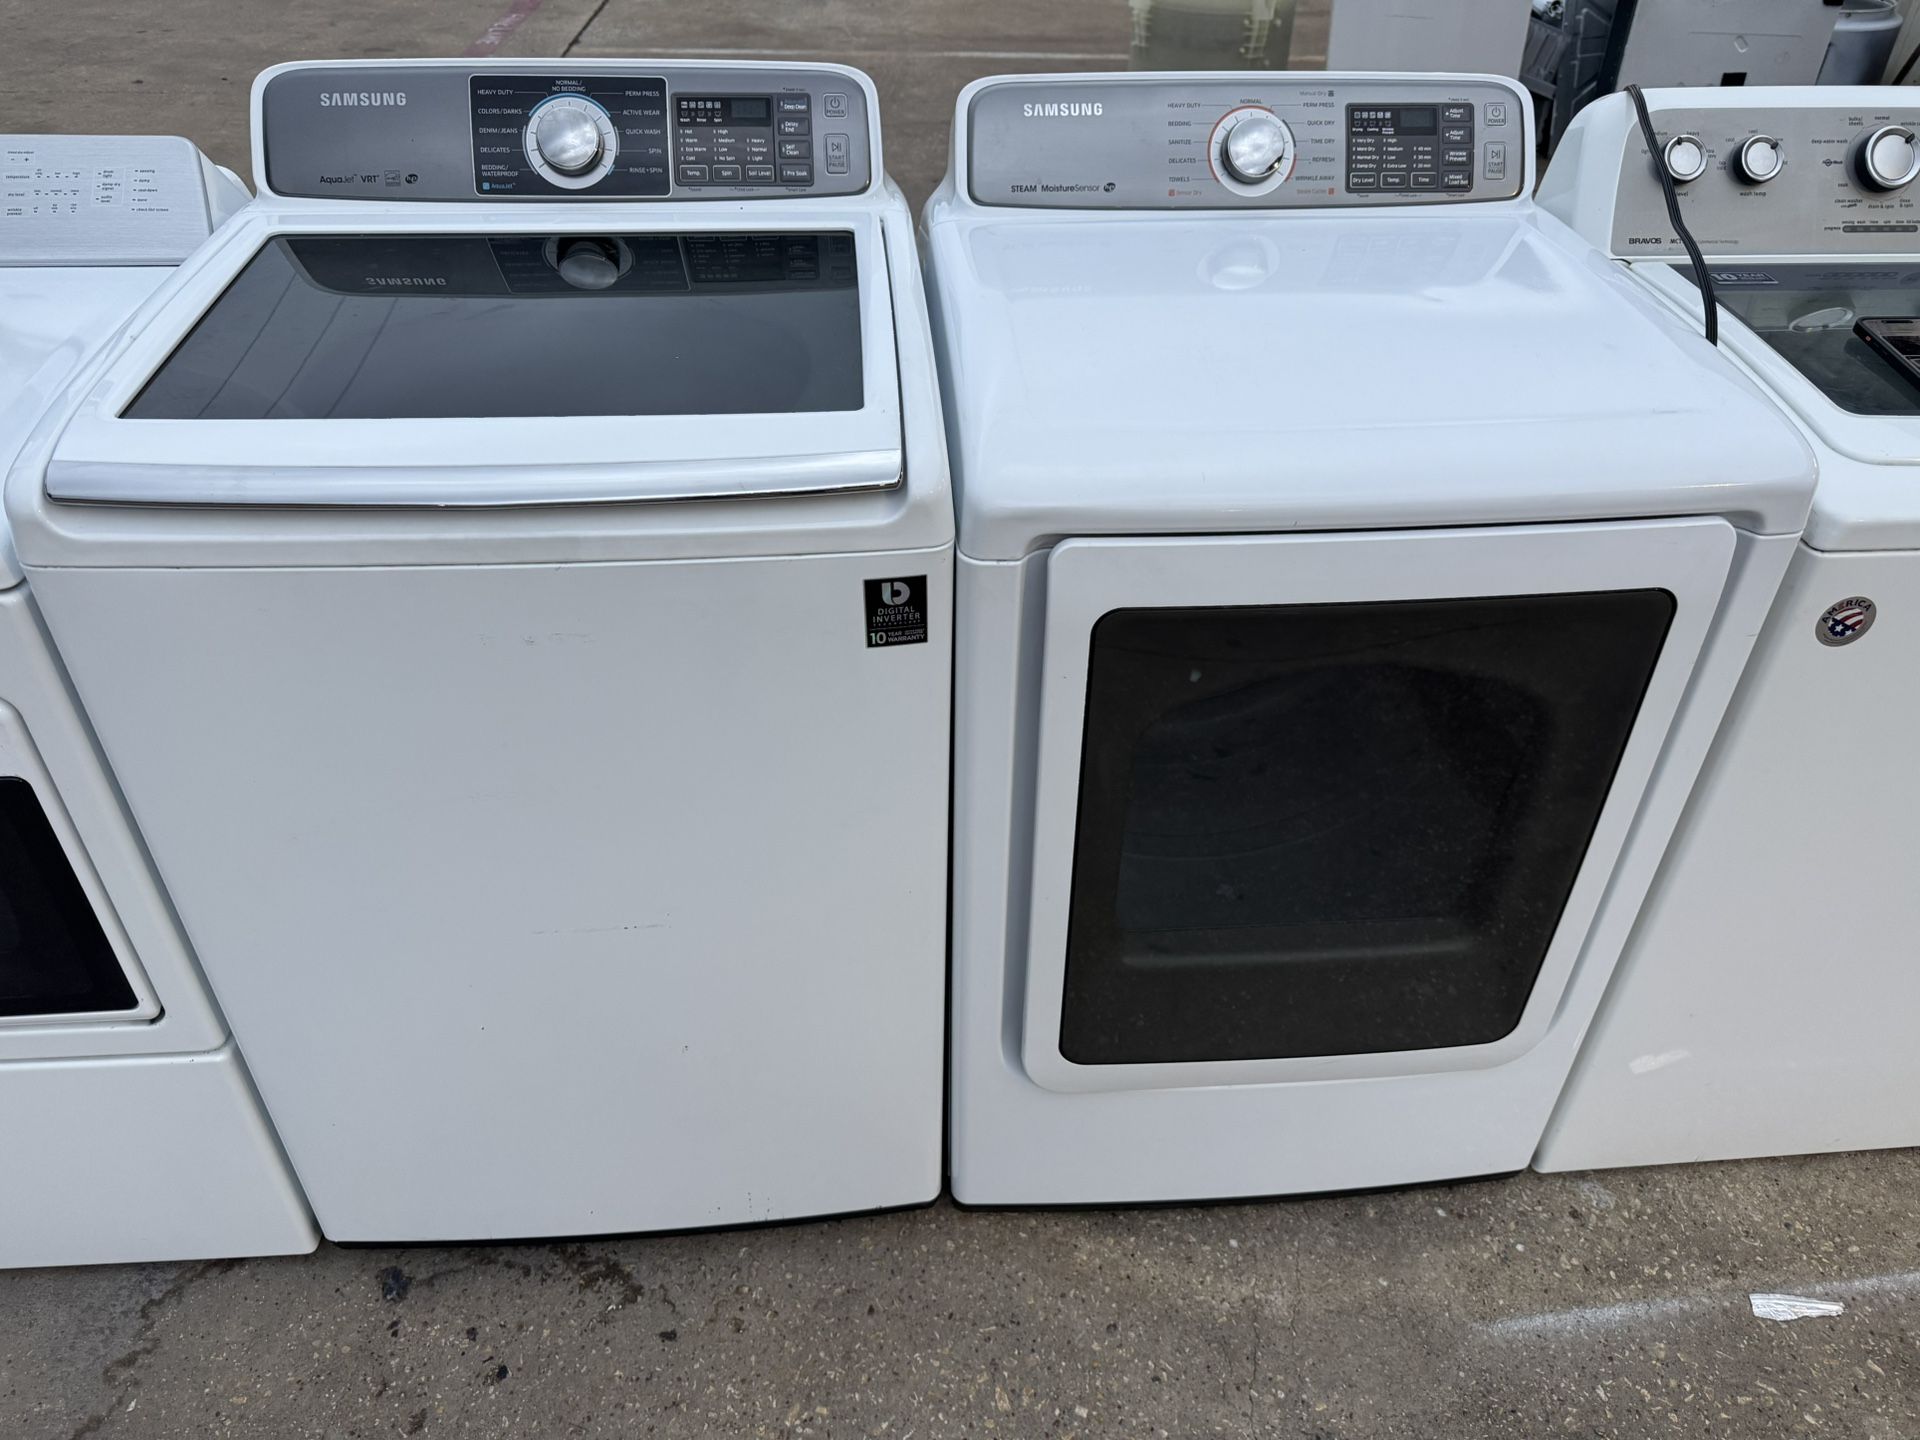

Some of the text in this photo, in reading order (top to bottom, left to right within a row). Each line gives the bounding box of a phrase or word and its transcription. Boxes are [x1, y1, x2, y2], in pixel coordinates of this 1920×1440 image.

[320, 92, 407, 107] SAMSUNG
[1023, 102, 1103, 117] SAMSUNG
[1011, 184, 1099, 193] STEAM MoistureSensor
[878, 606, 915, 615] DIGITAL
[1821, 599, 1872, 623] AMERICA
[873, 613, 920, 623] INVERTER
[870, 632, 887, 645] 10
[888, 634, 925, 642] WARRANTY
